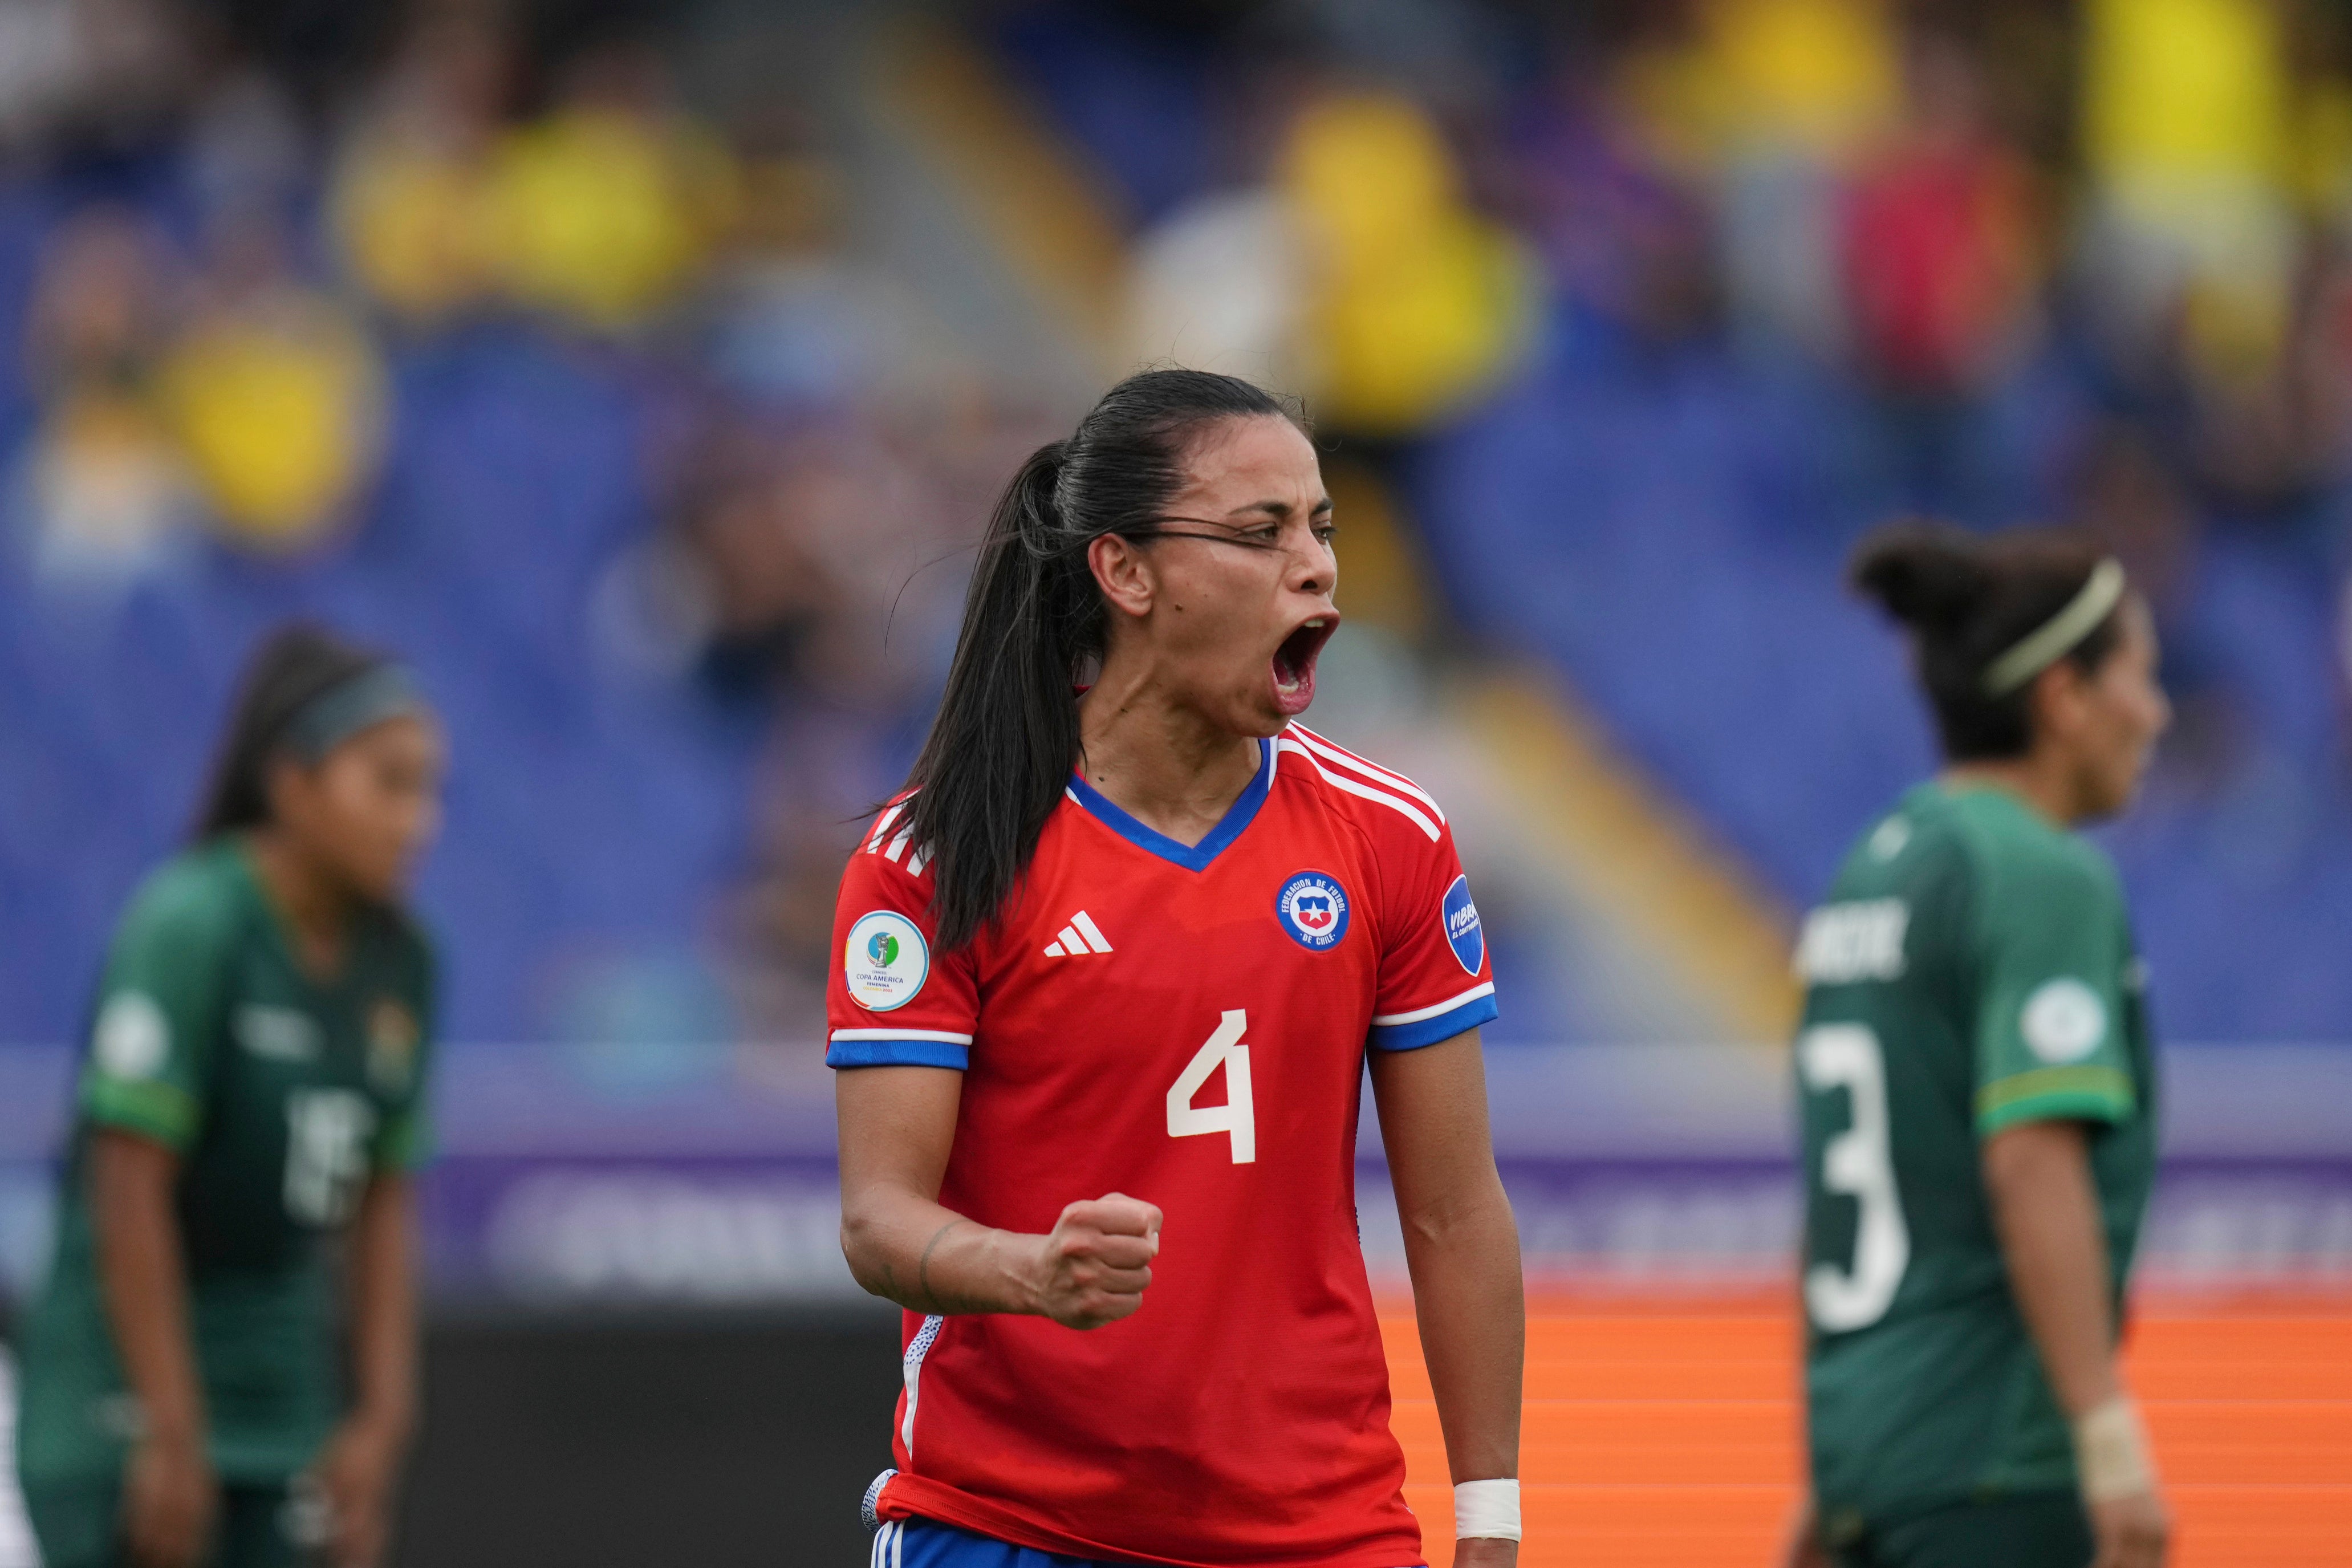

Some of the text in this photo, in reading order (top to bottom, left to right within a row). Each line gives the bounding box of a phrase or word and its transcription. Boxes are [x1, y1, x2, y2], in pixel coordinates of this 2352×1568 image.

[1281, 878, 1346, 913] FEDERACION DE FUTBOL
[1302, 933, 1335, 945] DE CHILE
[1452, 931, 1459, 940] EL
[873, 975, 904, 984] AMERICA
[1167, 1008, 1256, 1164] 4
[1799, 1023, 1911, 1333] 3
